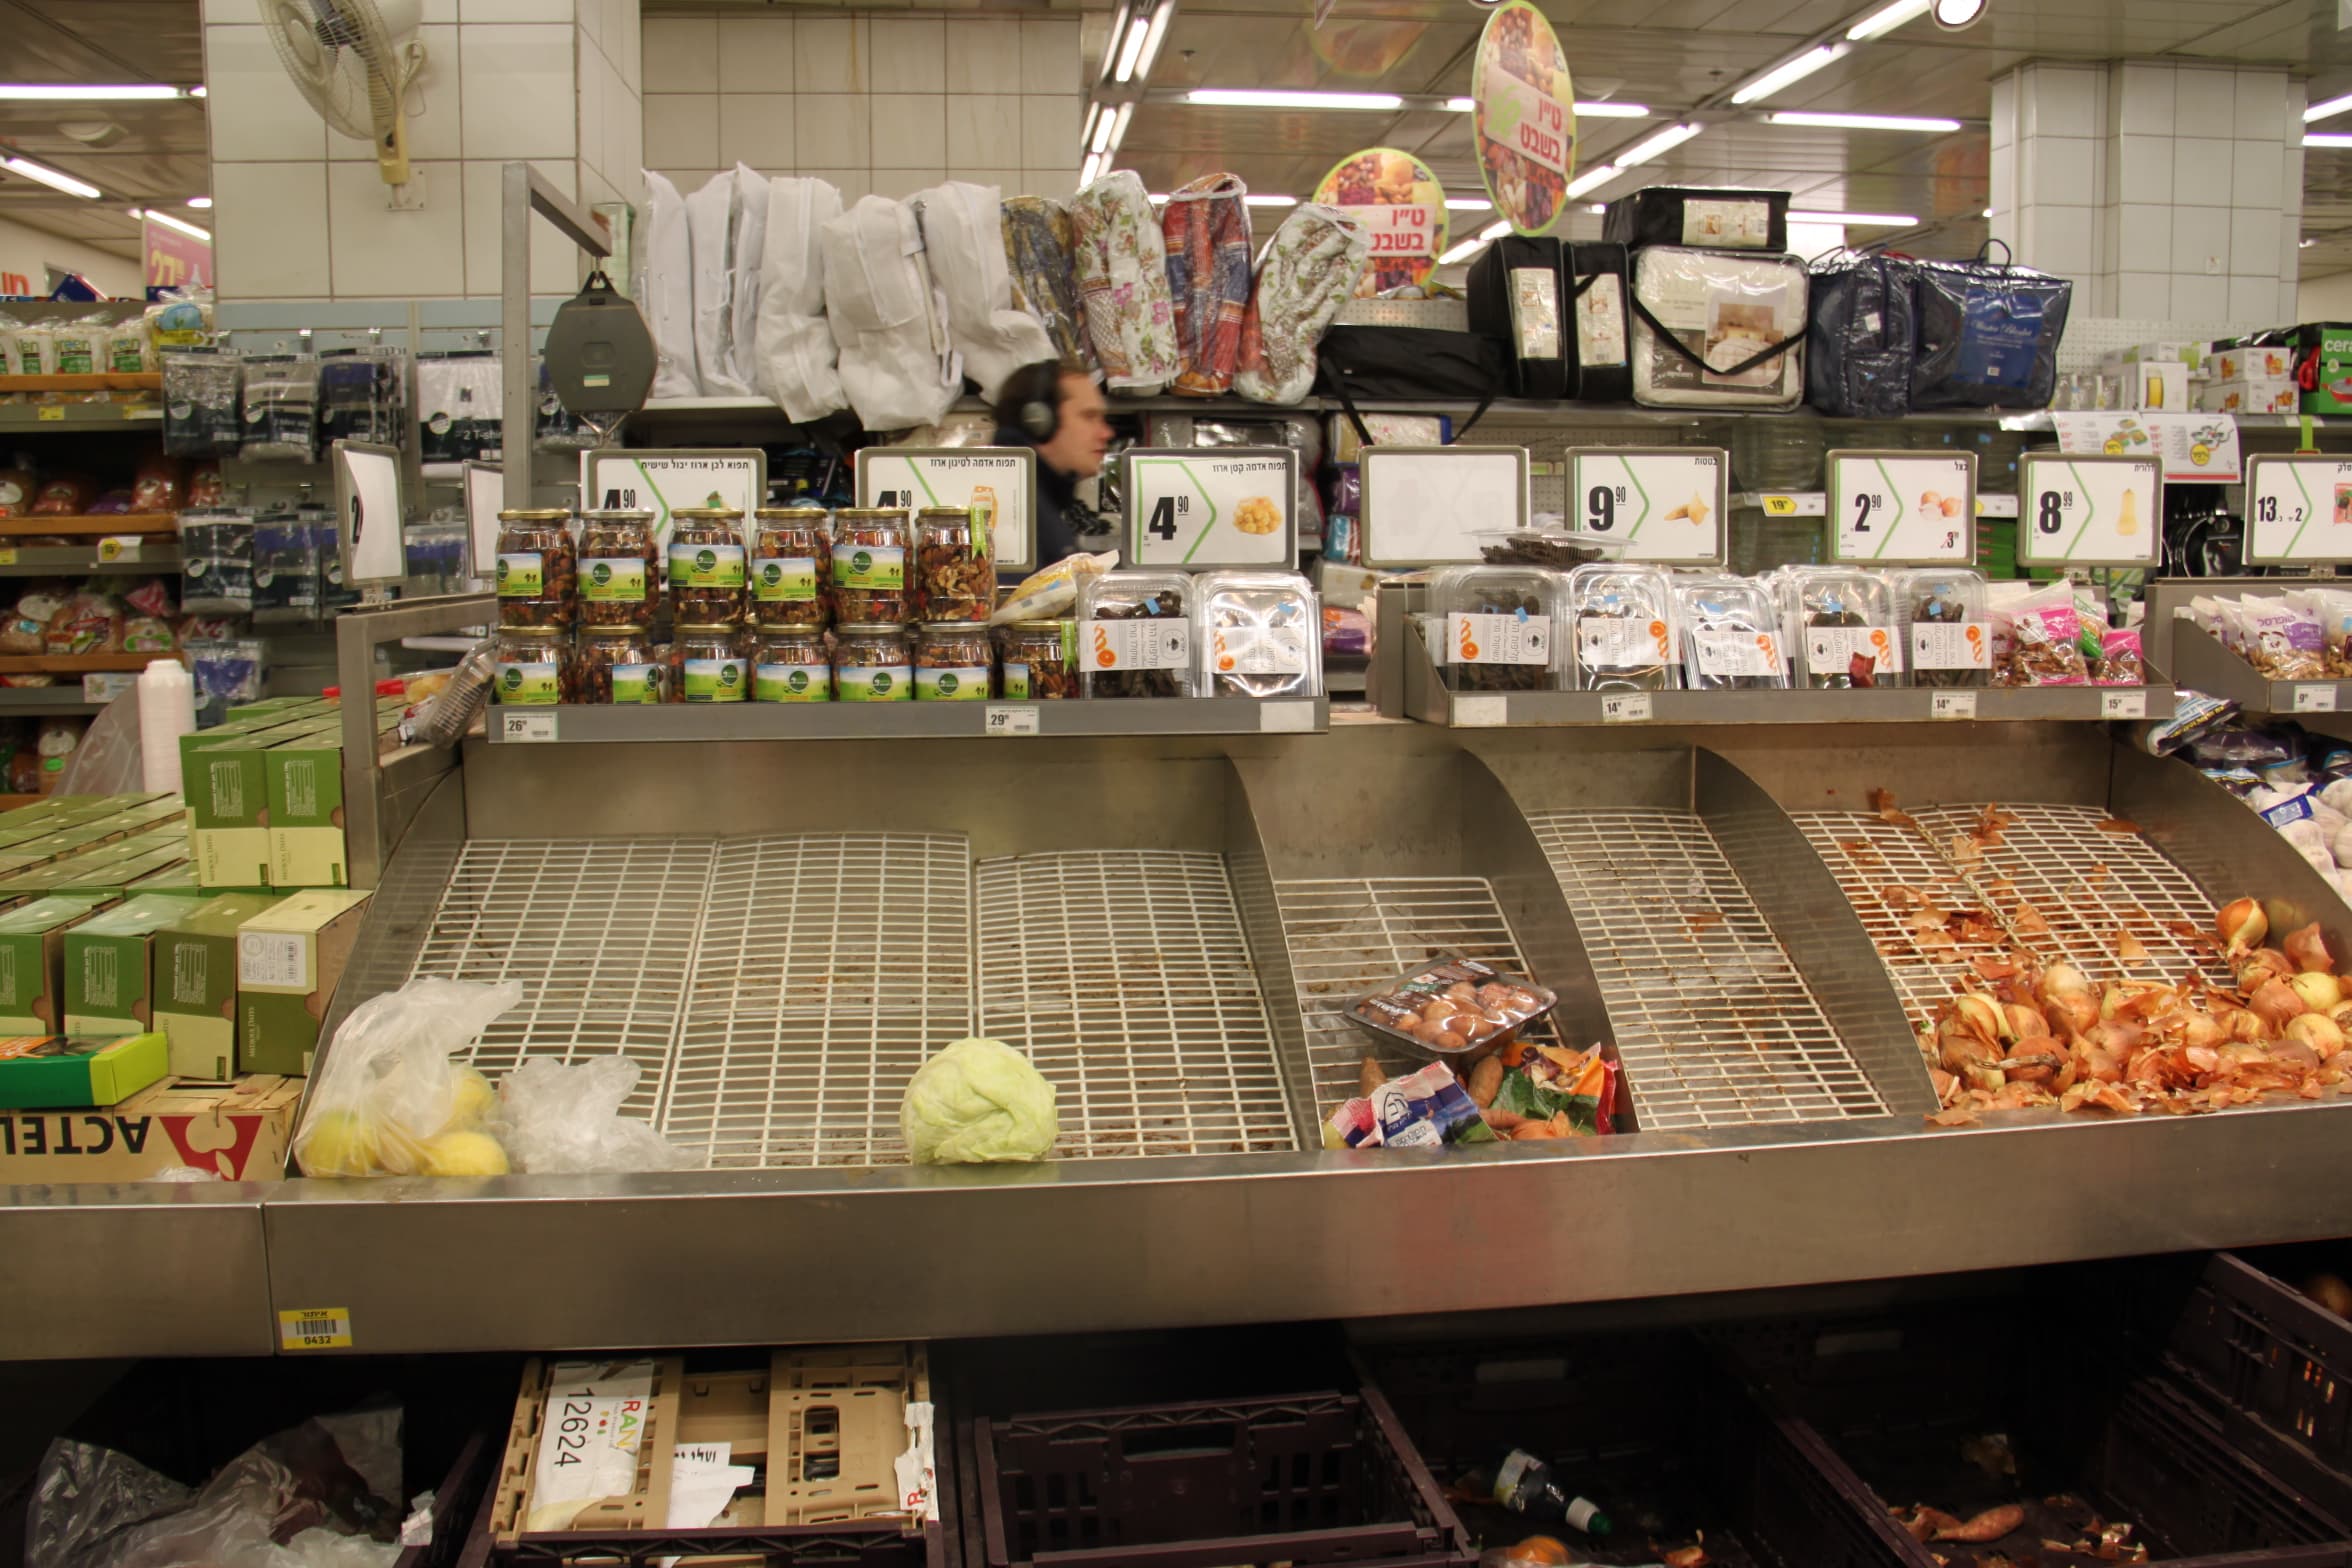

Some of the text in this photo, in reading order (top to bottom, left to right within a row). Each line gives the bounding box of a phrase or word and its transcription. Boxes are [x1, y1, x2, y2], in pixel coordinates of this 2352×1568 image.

[1520, 122, 1561, 166] בשבט
[463, 430, 471, 440] 2
[995, 458, 1016, 467] תפוח
[623, 489, 636, 509] 90
[900, 490, 912, 508] 90
[1588, 486, 1626, 531] 9 90
[2258, 496, 2277, 522] 13
[1149, 496, 1189, 541] 4 90
[1854, 493, 1882, 532] 2 90
[2039, 491, 2062, 534] 8
[2295, 507, 2303, 523] 2
[1606, 702, 1618, 713] 14
[508, 720, 522, 731] 26
[990, 714, 1004, 725] 29
[554, 1387, 596, 1467] 12624
[615, 1400, 642, 1448] RAN
